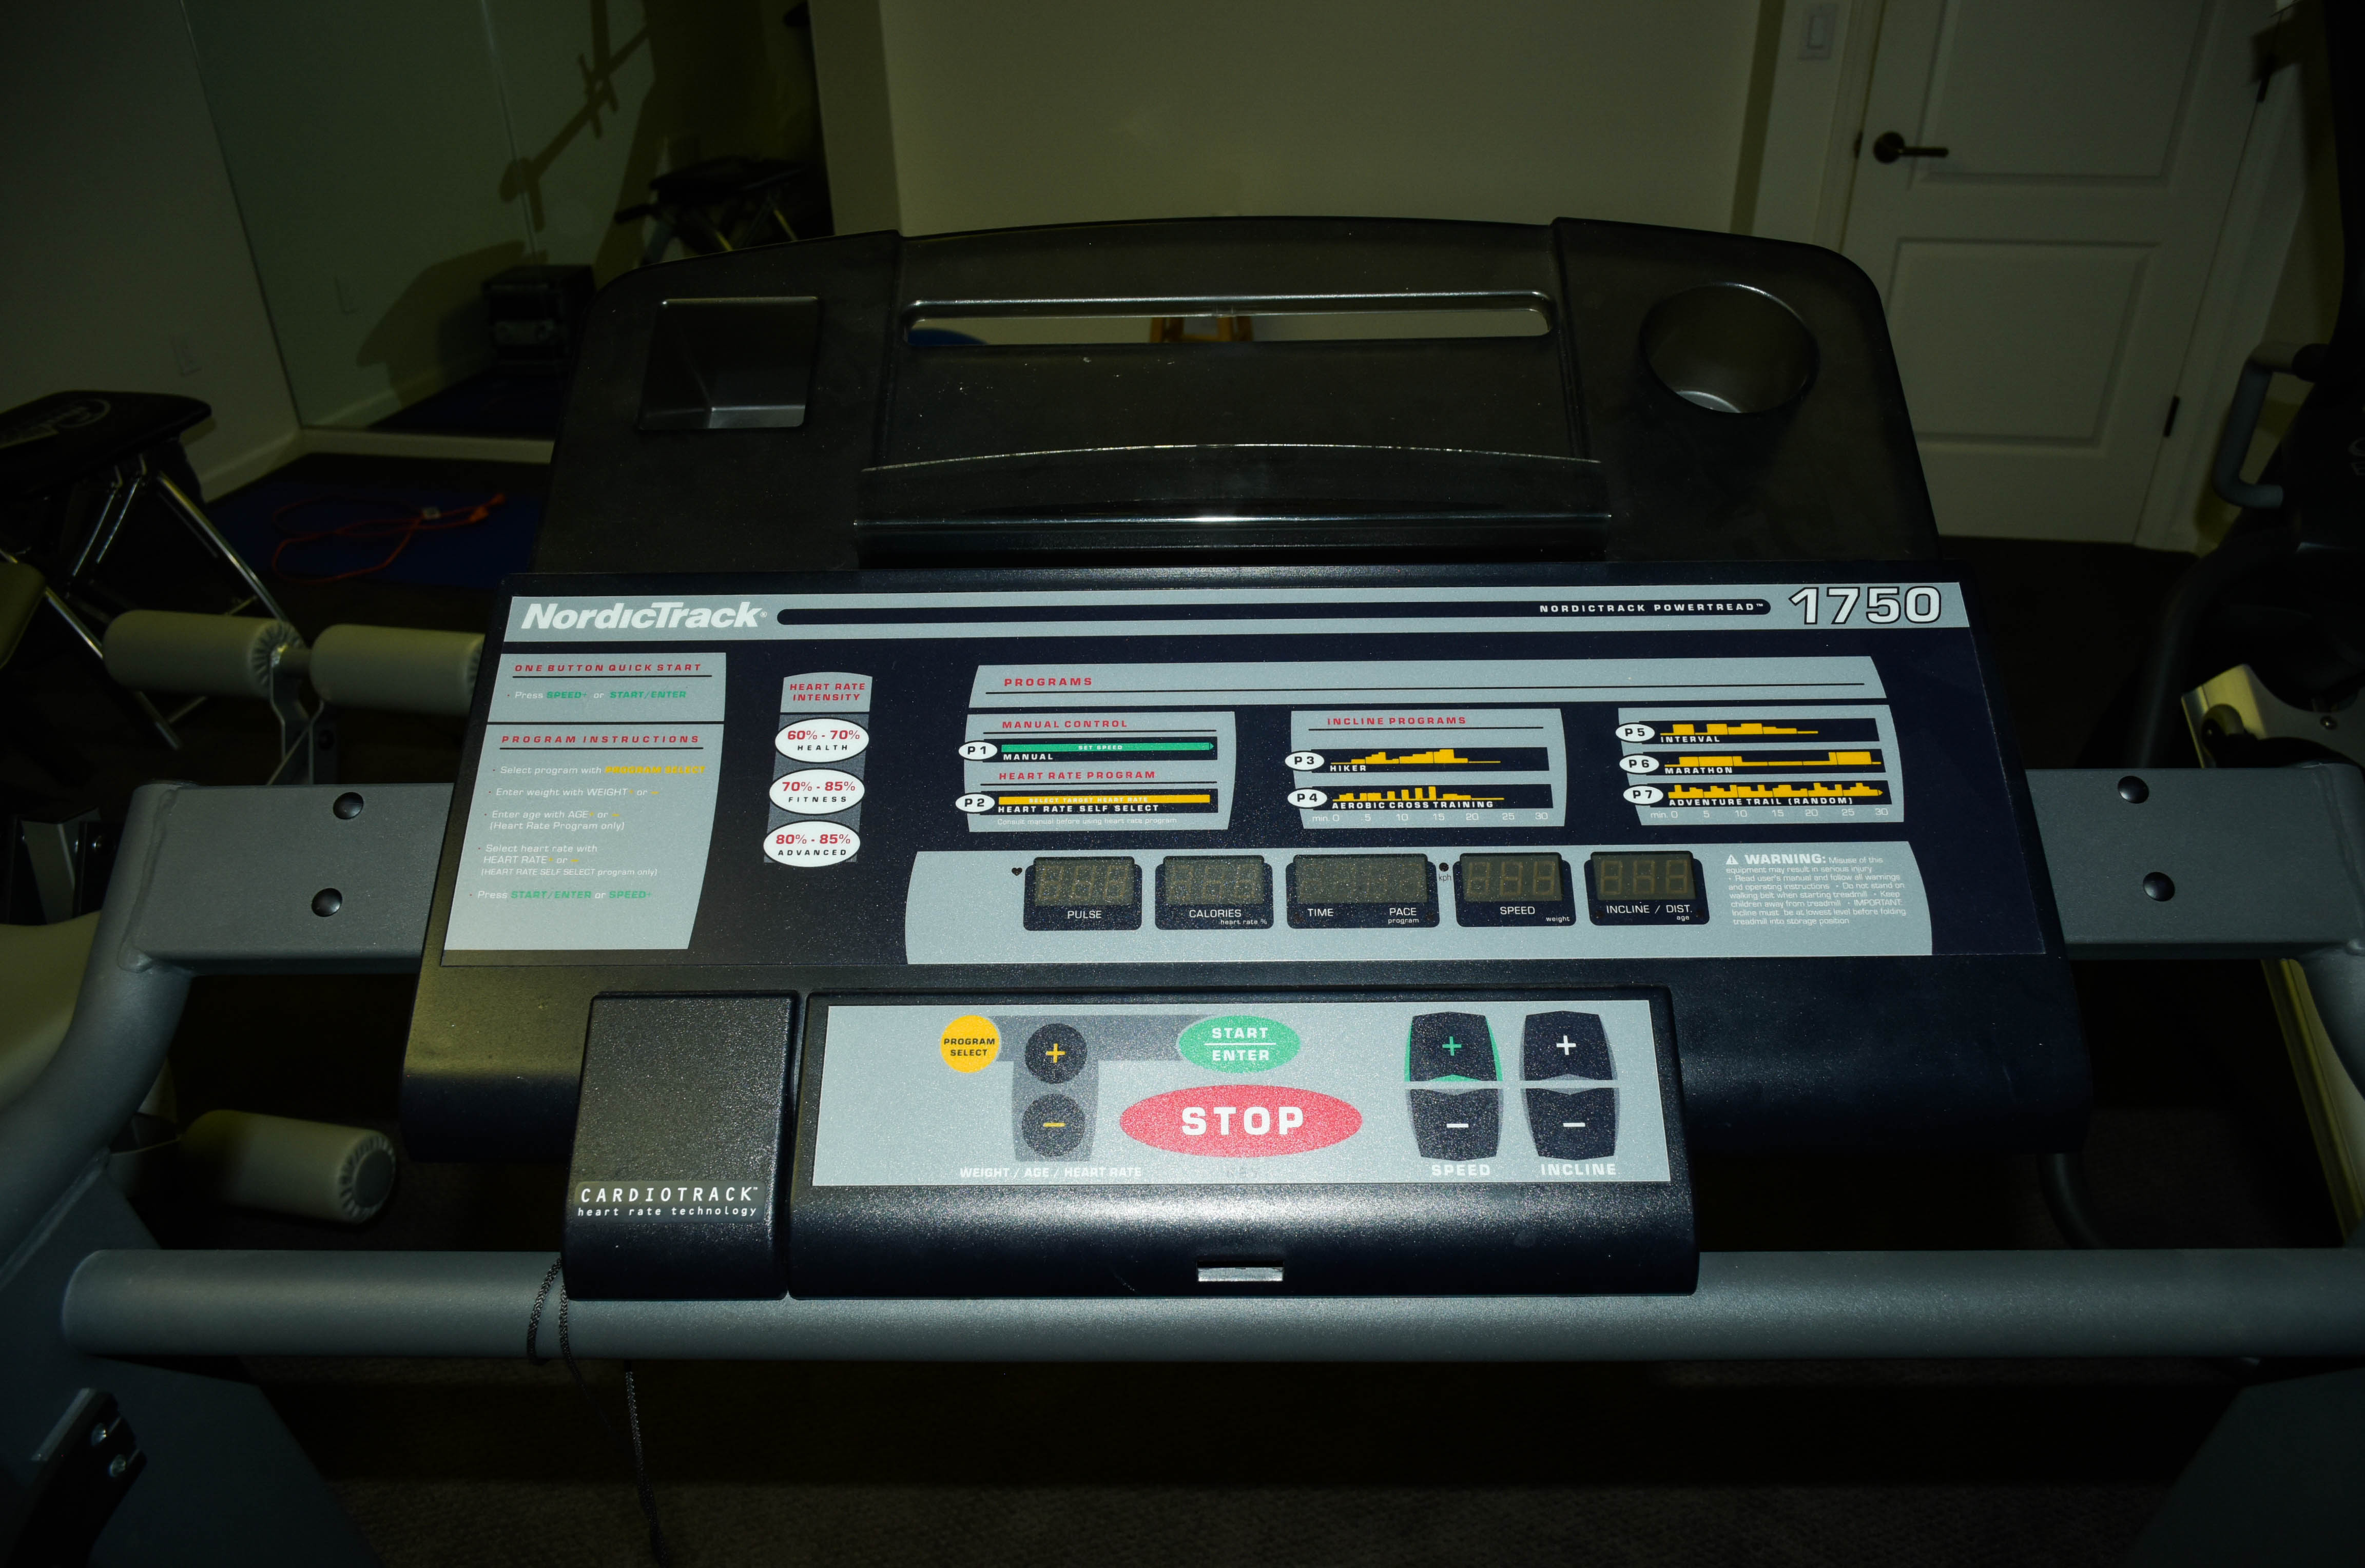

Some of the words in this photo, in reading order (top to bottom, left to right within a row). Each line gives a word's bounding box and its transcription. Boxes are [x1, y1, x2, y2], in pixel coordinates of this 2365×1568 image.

[1540, 604, 1645, 613] NORDICTRACK
[1788, 585, 1942, 625] 1750
[1004, 677, 1093, 687] PROGRAMS
[610, 691, 686, 699] START/ENTER
[1002, 720, 1060, 729] MANUAL
[1064, 720, 1128, 728] CONTROL
[787, 730, 817, 740] 60%
[830, 730, 860, 739] 70%
[1660, 735, 1720, 743] INTERVAL
[500, 766, 532, 774] Select
[535, 767, 577, 776] program
[1087, 771, 1155, 779] PROGRAM
[1664, 767, 1733, 775] MARATHON
[782, 781, 812, 792] 70%
[825, 781, 856, 791] 85%
[496, 788, 524, 796] Enter
[527, 788, 560, 798] weight
[563, 788, 583, 796] with
[1669, 798, 1742, 806] ADVENTURE
[1746, 797, 1781, 806] TRAIL
[1788, 796, 1853, 805] (RANDOM)
[492, 810, 520, 818] Enter
[522, 811, 540, 820] age
[544, 810, 565, 818] with
[1772, 809, 1784, 817] 15
[1875, 808, 1889, 816] 30
[490, 821, 522, 831] (Heart
[525, 821, 550, 830] Rate
[553, 821, 597, 832] Program
[601, 821, 625, 831] only)
[776, 834, 807, 845] 80%
[819, 834, 851, 844] 85%
[576, 844, 597, 852] with
[483, 856, 518, 864] HEART
[1745, 853, 1826, 865] WARNING:
[597, 869, 634, 877] program
[637, 868, 657, 877] only)
[1438, 873, 1451, 883] kph
[478, 891, 508, 899] Press
[511, 891, 592, 899] START/ENTER
[1189, 909, 1242, 918] CALORIES
[1307, 908, 1334, 917] TIME
[1389, 908, 1417, 916] PACE
[1500, 906, 1535, 915] SPEED
[1606, 905, 1650, 914] INCLINE
[1666, 904, 1693, 913] DIST.
[1067, 910, 1102, 919] PULSE
[1212, 1027, 1269, 1038] START
[944, 1037, 996, 1046] PROGRAM
[949, 1049, 988, 1057] SELECT
[1212, 1050, 1270, 1061] ENTER
[1182, 1107, 1304, 1136] STOP
[960, 1167, 1008, 1179] WEIGHT
[1024, 1167, 1050, 1178] AGE
[1064, 1167, 1105, 1178] HEART
[1109, 1167, 1142, 1178] RATE
[1431, 1164, 1490, 1177] SPEED
[1541, 1164, 1616, 1175] INCLINE
[577, 1207, 618, 1217] heart
[629, 1207, 661, 1216] rate
[671, 1206, 757, 1218] technology
